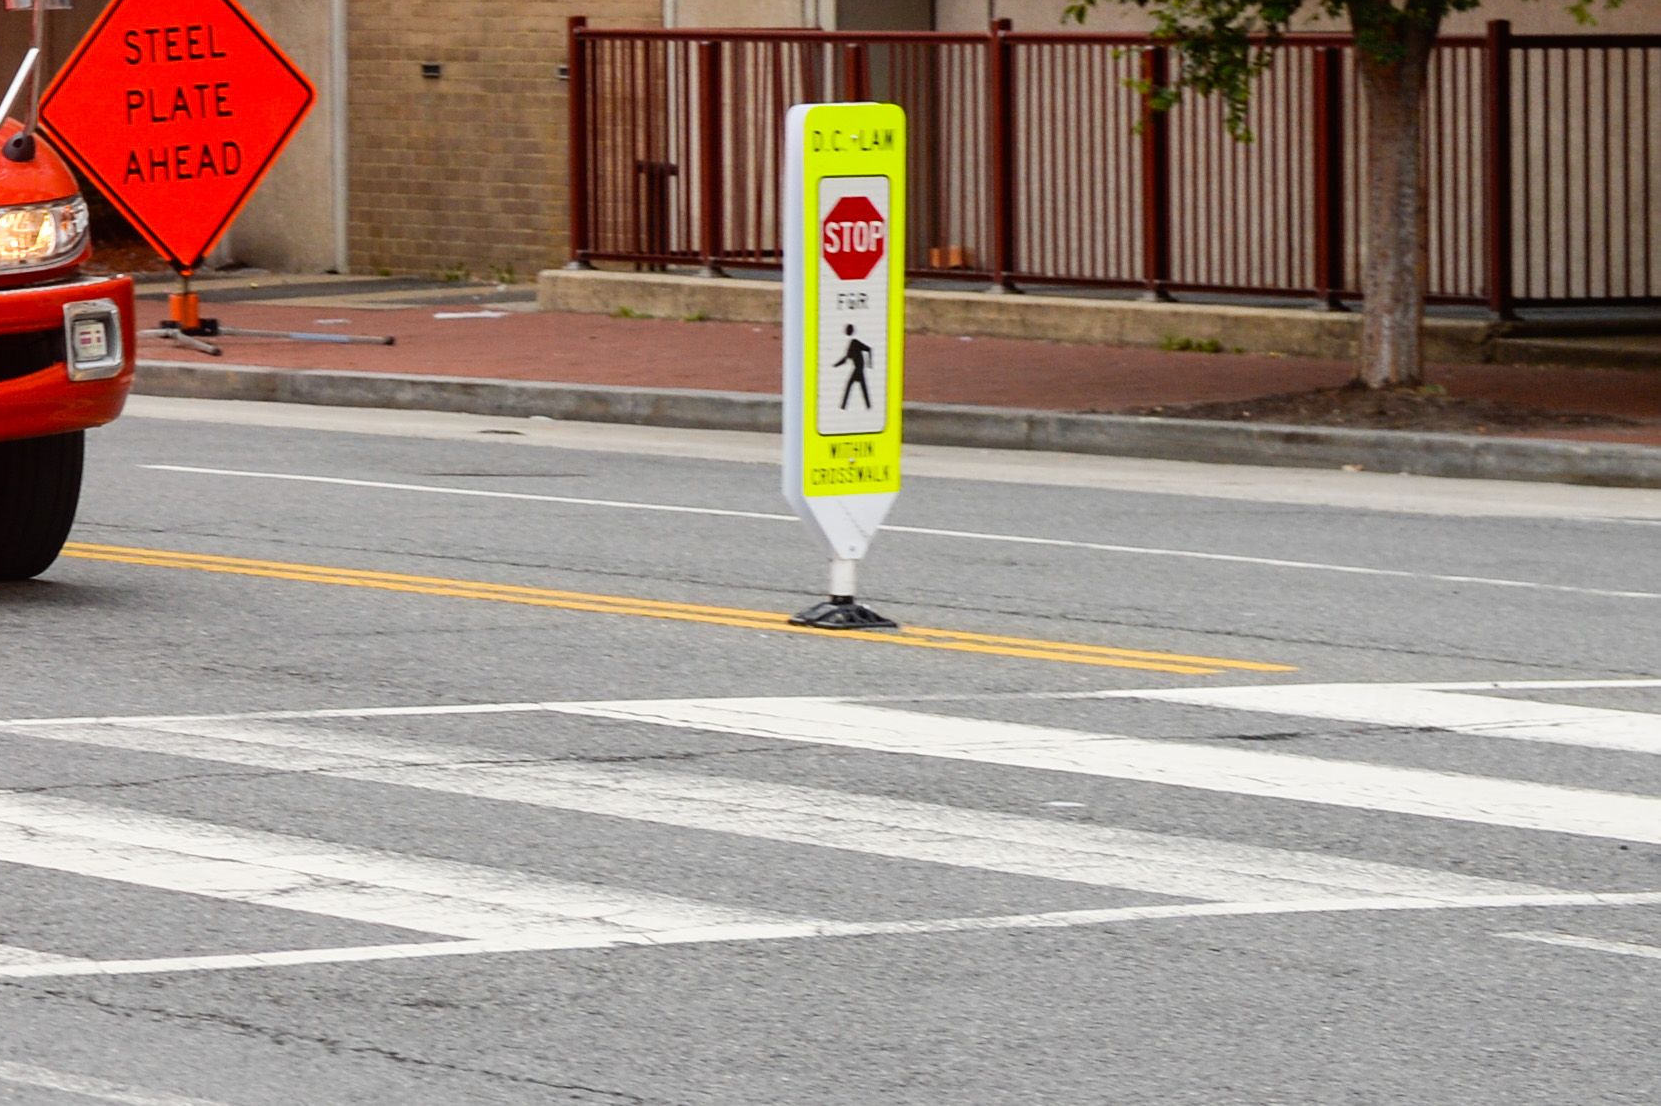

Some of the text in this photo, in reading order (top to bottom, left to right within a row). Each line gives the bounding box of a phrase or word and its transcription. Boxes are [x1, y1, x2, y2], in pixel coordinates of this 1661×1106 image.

[124, 25, 227, 65] STEEL
[126, 82, 234, 125] PLATE
[858, 128, 896, 152] LAW
[124, 142, 242, 185] AHEAD
[823, 220, 885, 254] STOP
[837, 291, 869, 310] FOR
[828, 440, 876, 459] WITHIN
[811, 464, 891, 486] CROSSWALK
